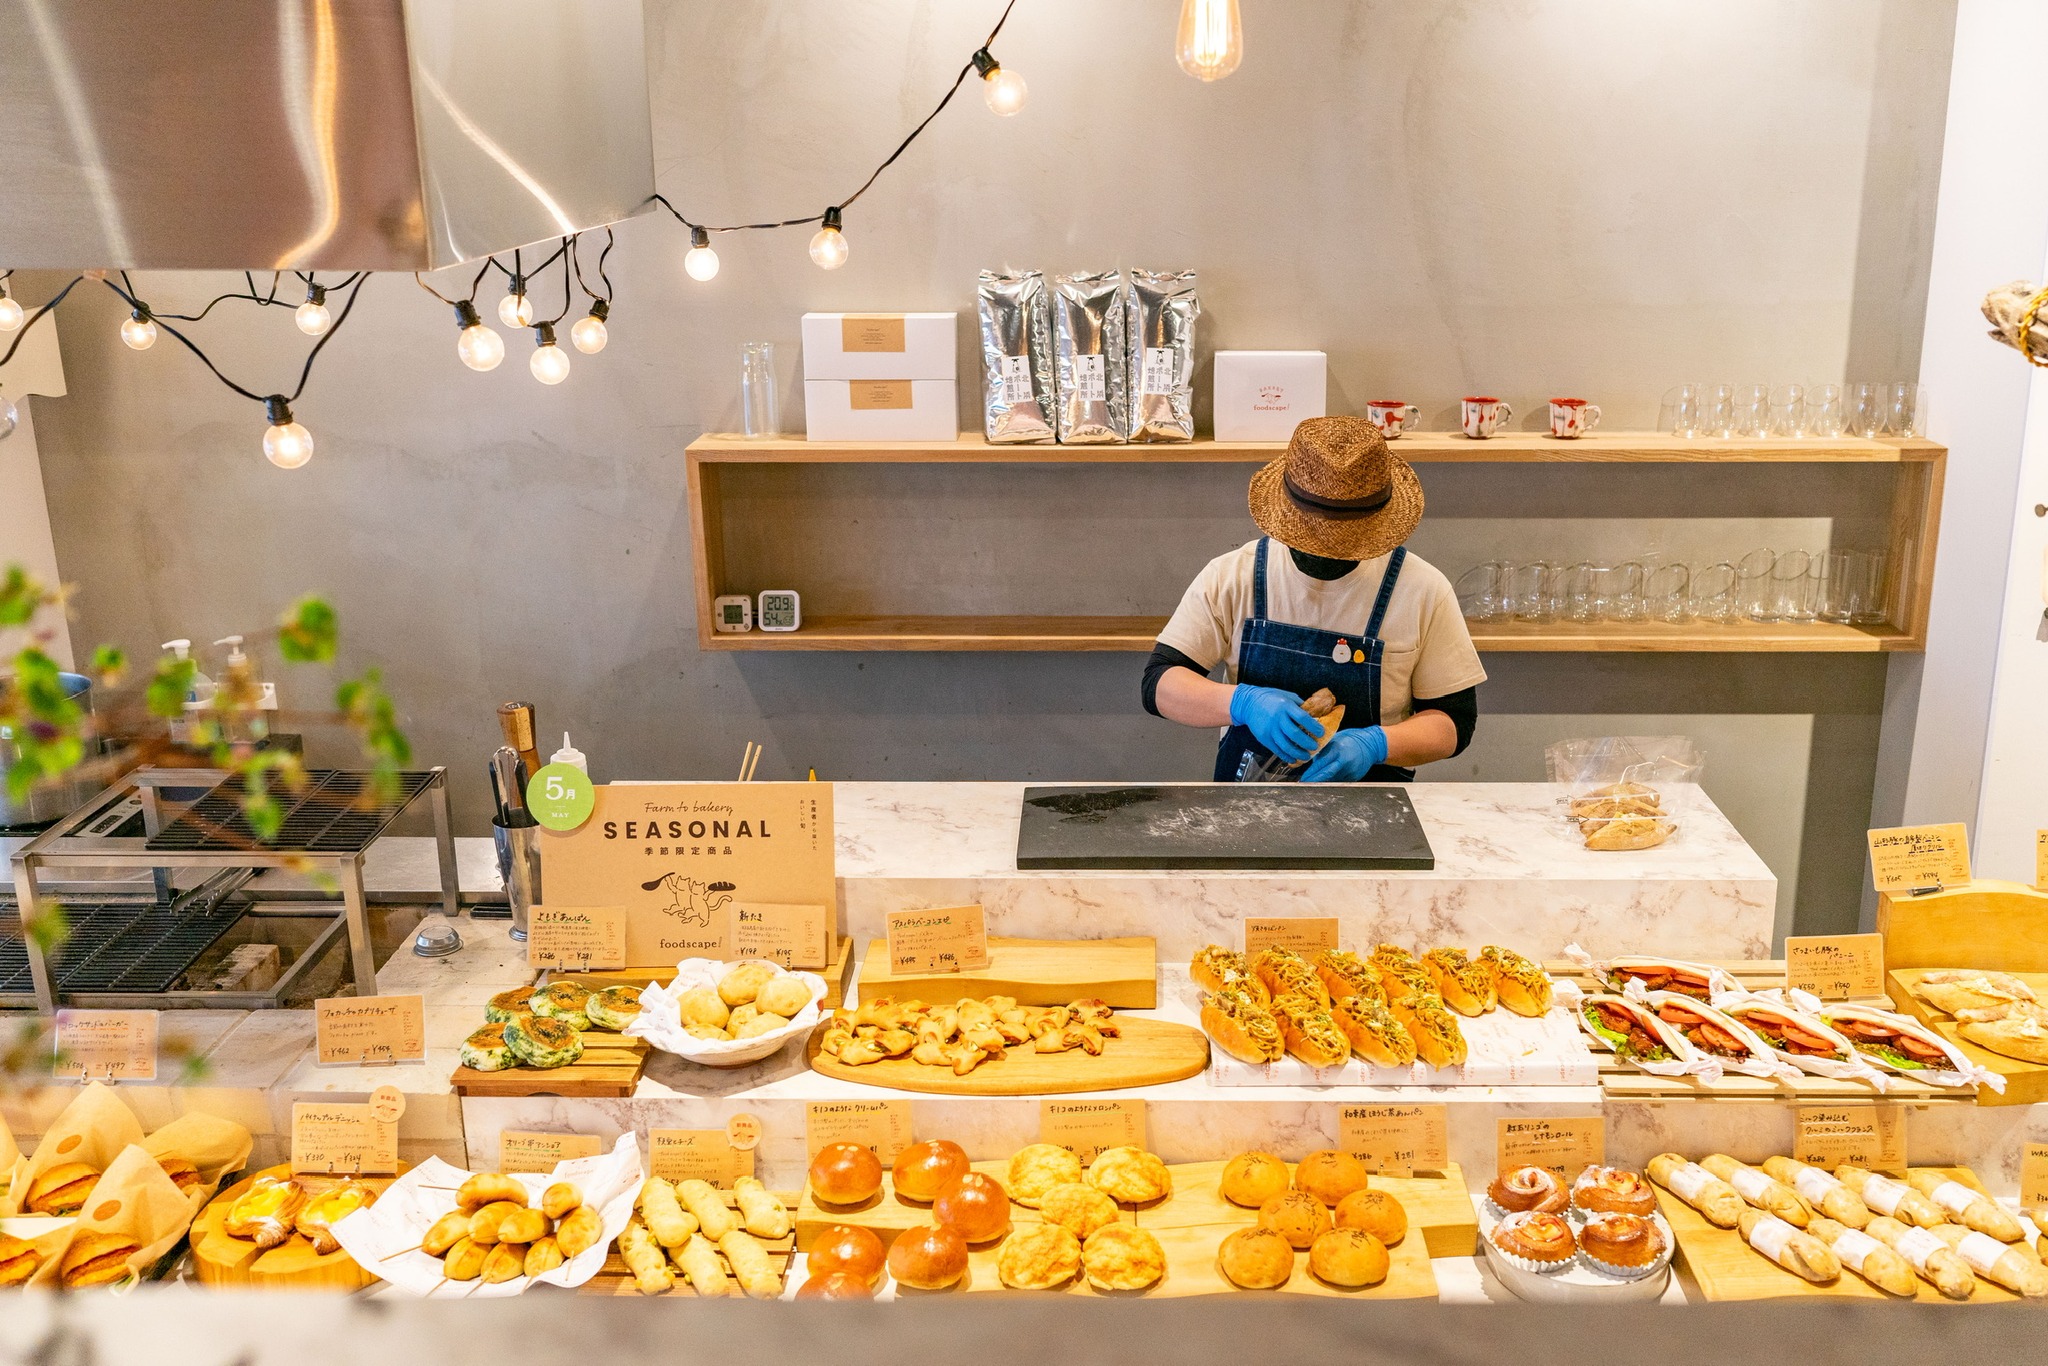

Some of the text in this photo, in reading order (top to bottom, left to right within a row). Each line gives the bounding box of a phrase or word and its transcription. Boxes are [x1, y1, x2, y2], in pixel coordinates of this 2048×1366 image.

[545, 776, 576, 800] 5月
[645, 801, 734, 816] Farm to bakery
[603, 820, 771, 840] SEASONAL
[645, 846, 733, 856] 季節限定商品
